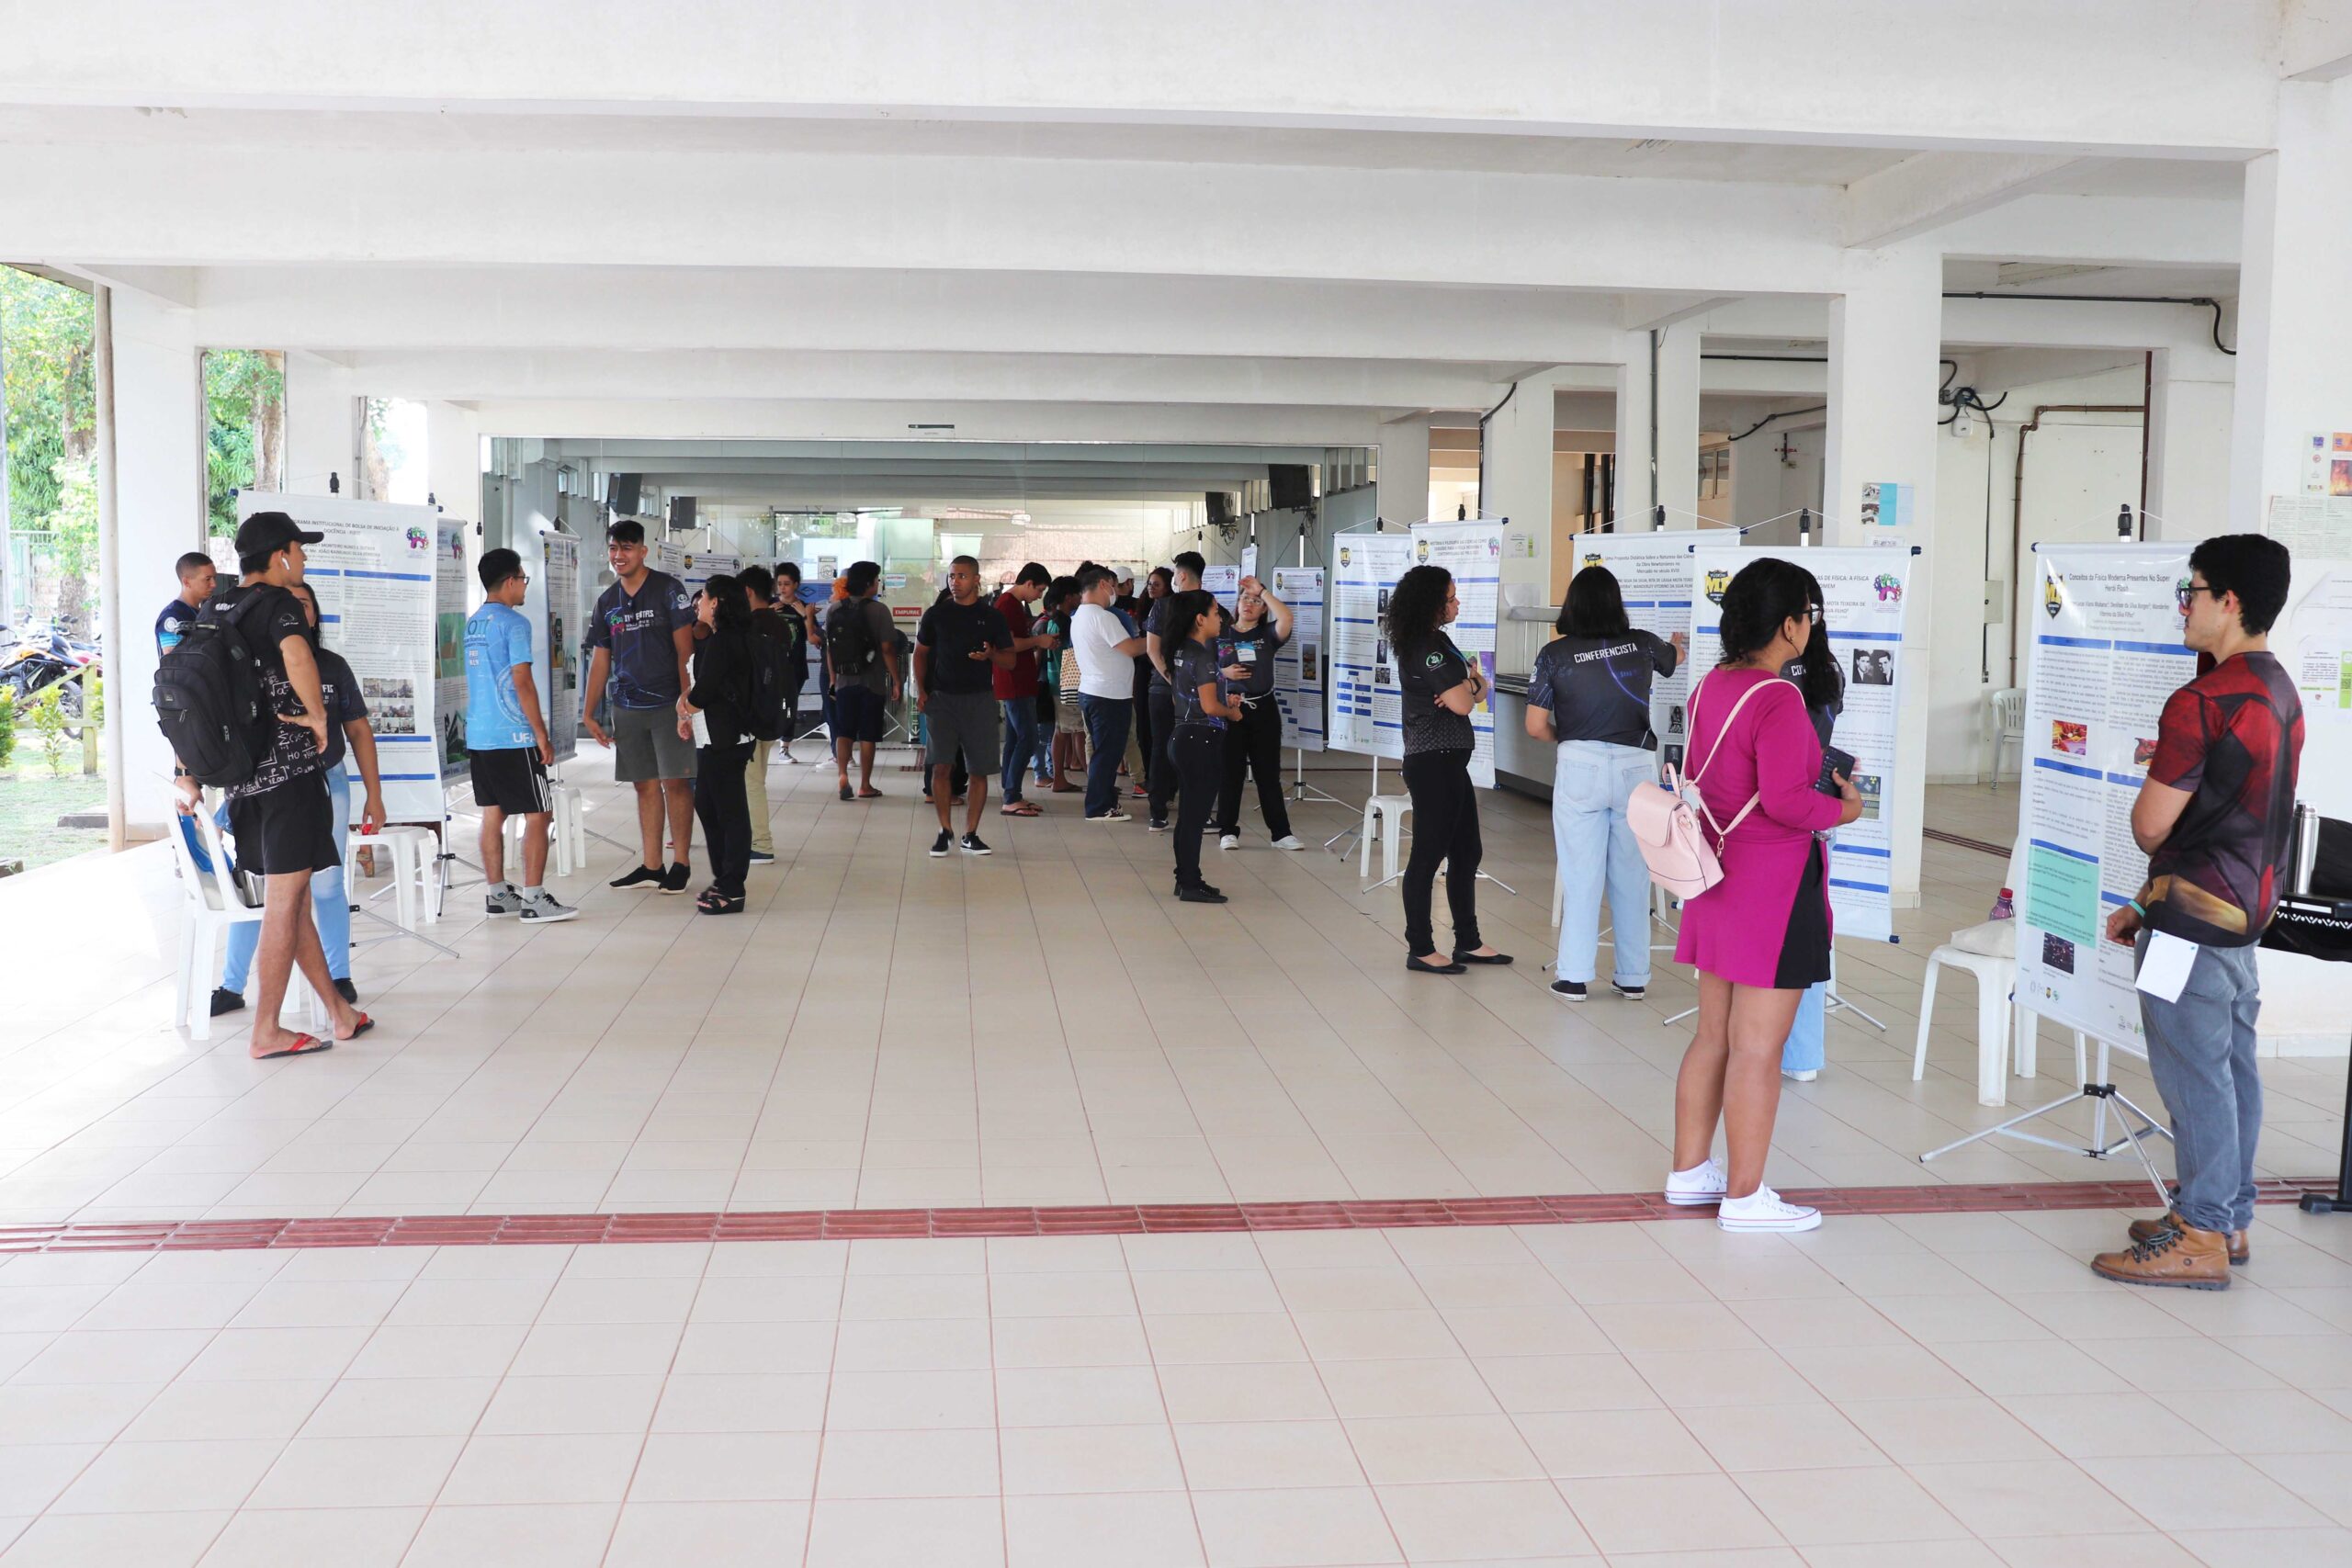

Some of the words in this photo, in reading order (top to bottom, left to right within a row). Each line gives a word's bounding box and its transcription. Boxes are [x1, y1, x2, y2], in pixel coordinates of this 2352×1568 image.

[2156, 574, 2170, 582] Super
[1574, 642, 1638, 663] CONFERENCISTA
[322, 684, 334, 694] FIS
